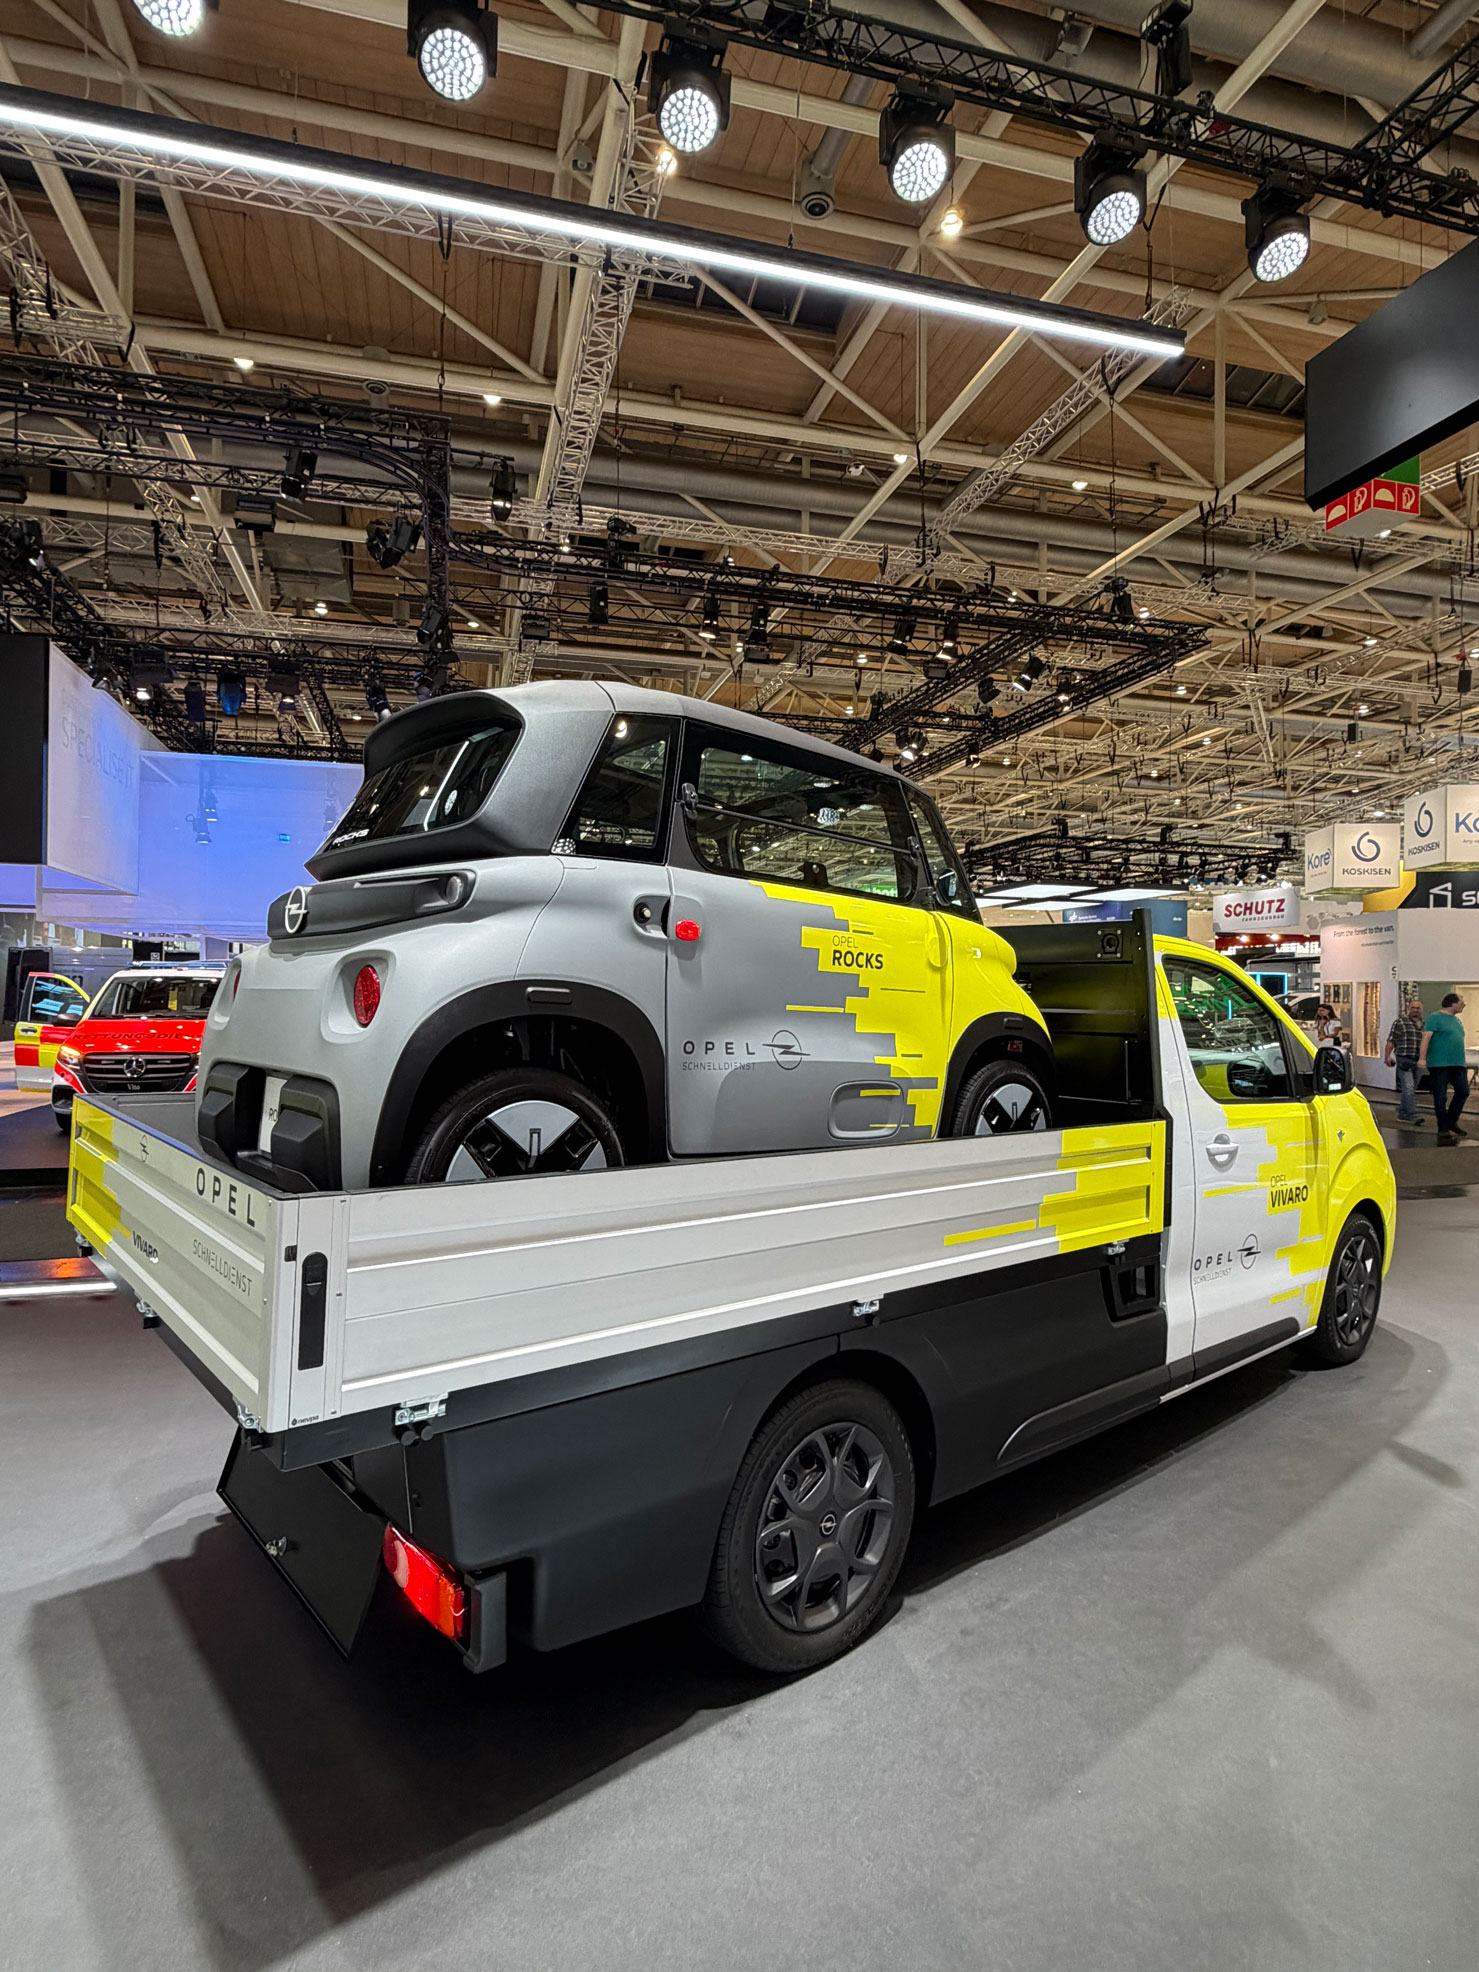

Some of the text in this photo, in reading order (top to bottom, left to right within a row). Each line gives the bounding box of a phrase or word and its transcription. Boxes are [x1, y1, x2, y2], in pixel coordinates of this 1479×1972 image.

[1408, 841, 1440, 856] KOSKISEN
[1342, 867, 1392, 876] KOSKISEN
[1224, 898, 1286, 918] SCHUTZ
[832, 935, 859, 949] OPEL
[831, 949, 884, 970] ROCKS
[683, 1040, 756, 1056] OPEL
[682, 1061, 756, 1071] SCHNELLDIENST
[127, 1083, 141, 1092] Vito
[268, 1108, 278, 1122] RO
[1270, 1174, 1288, 1188] OPEL
[196, 1167, 256, 1228] OPEL
[1270, 1185, 1309, 1208] VIVARO
[132, 1230, 159, 1259] VIVARO
[192, 1239, 253, 1297] SCHNELLDIENST
[1193, 1251, 1233, 1271] OPEL
[1193, 1267, 1232, 1285] SCHNELLDIENST
